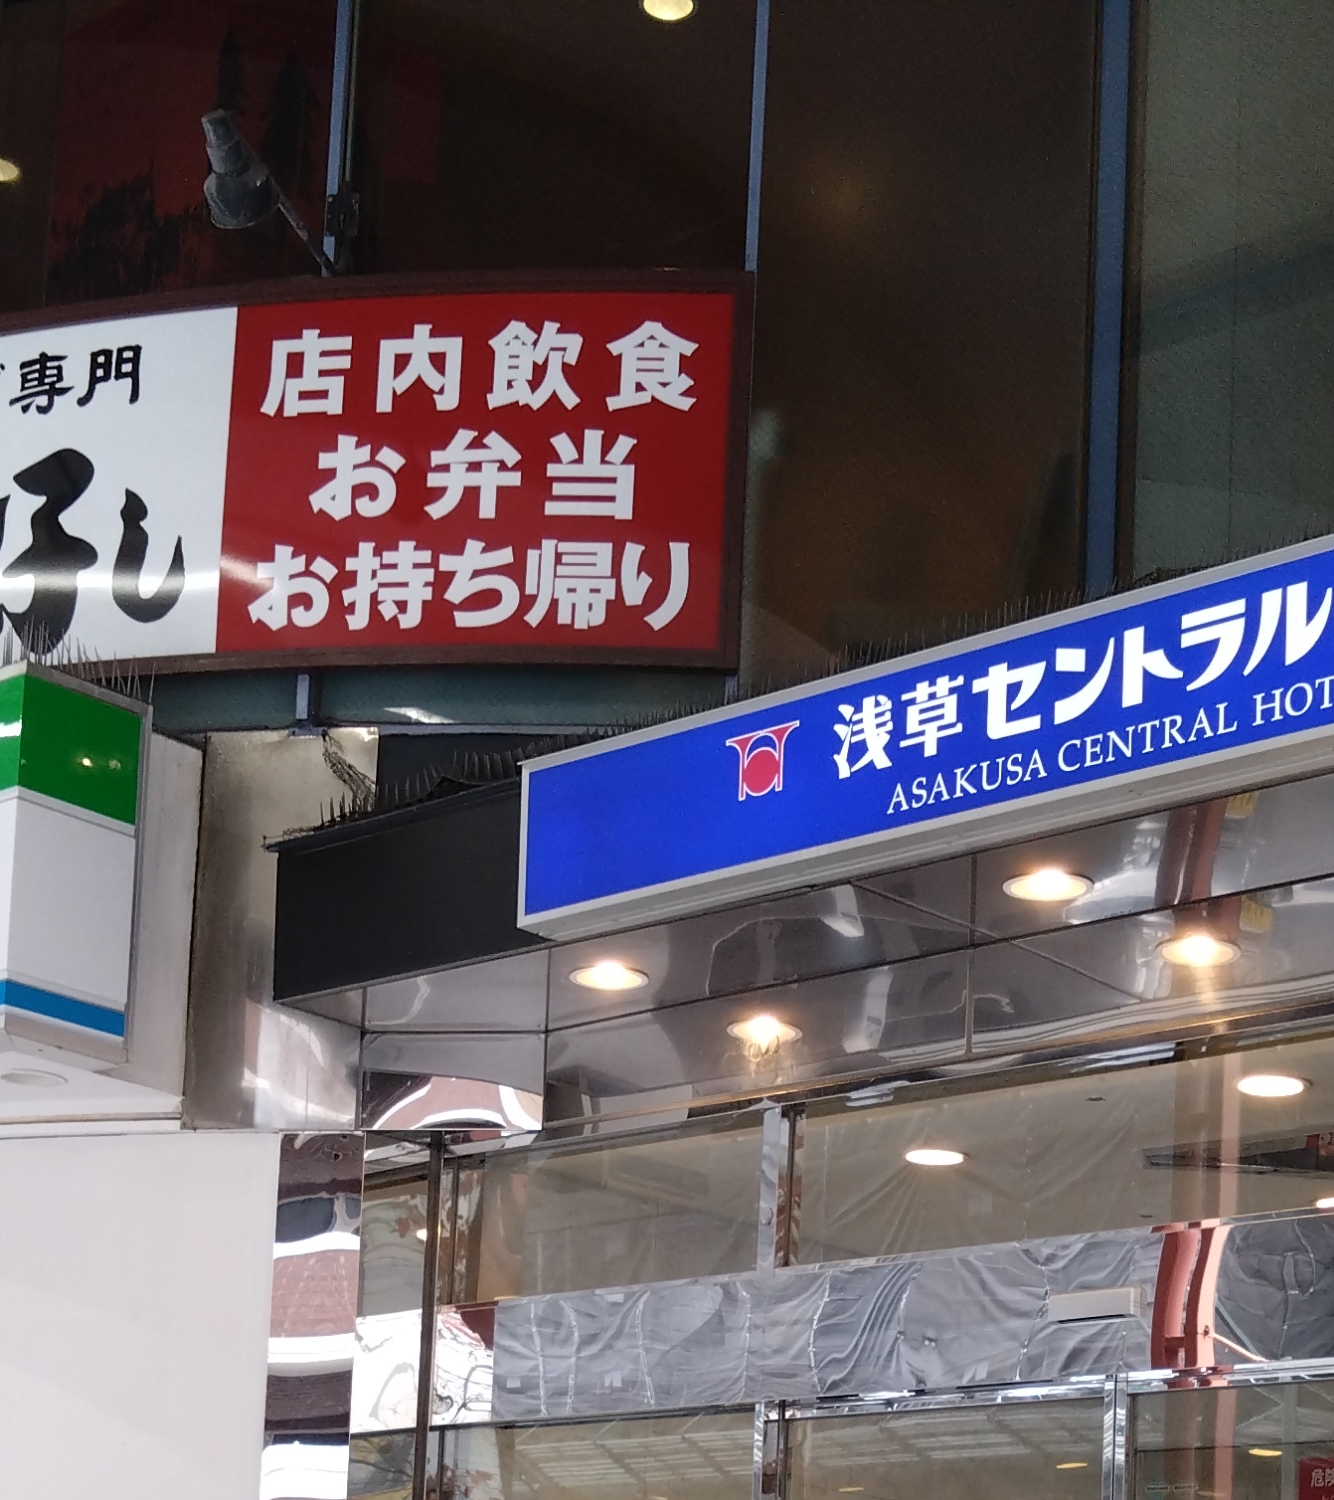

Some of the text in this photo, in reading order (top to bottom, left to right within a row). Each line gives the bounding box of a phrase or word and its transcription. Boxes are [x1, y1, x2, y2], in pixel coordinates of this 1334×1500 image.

[259, 319, 699, 418] 店内飲食
[308, 427, 638, 522] お弁当
[247, 537, 691, 632] お持ち帰り
[886, 751, 1046, 815] ASAKUSA
[1057, 702, 1239, 774] CENTRAL
